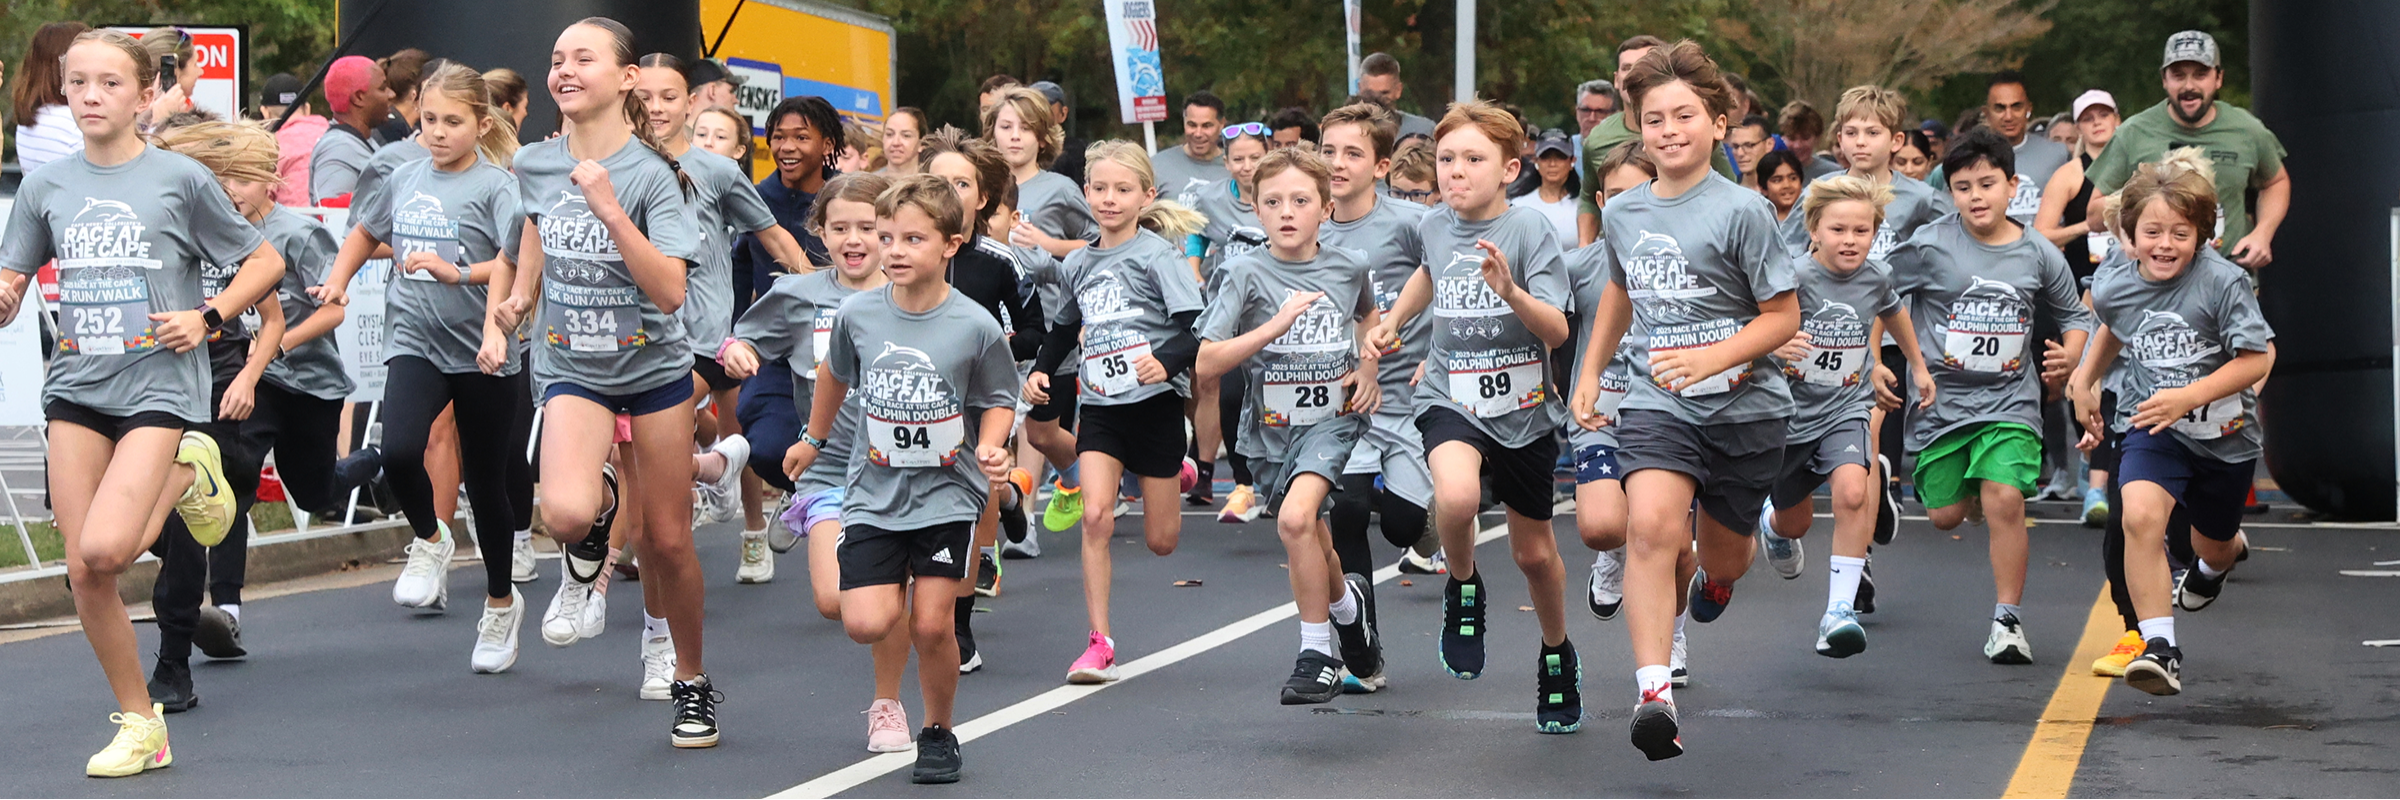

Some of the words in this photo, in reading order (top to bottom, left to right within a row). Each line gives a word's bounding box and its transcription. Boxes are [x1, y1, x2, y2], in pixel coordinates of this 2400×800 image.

[736, 85, 779, 111] ENSKE
[64, 226, 116, 244] RACE
[116, 225, 146, 241] AT
[393, 223, 400, 233] 5K
[402, 225, 454, 238] RUN/WALK
[540, 217, 588, 238] RACE
[588, 223, 609, 240] AT
[61, 241, 96, 258] THE
[98, 241, 151, 258] CAPE
[401, 238, 438, 260] 275
[570, 237, 619, 253] CAPE
[1626, 259, 1665, 276] RACE
[1667, 259, 1689, 275] AT
[74, 281, 88, 289] RACE
[89, 281, 97, 289] AT
[99, 280, 113, 288] THE
[114, 279, 134, 287] CAPE
[566, 284, 583, 294] RACE
[1437, 279, 1478, 296] RACE
[1480, 281, 1495, 295] A
[1626, 275, 1652, 290] THE
[1653, 274, 1699, 289] CAPE
[60, 289, 69, 301] 5K
[72, 286, 142, 302] RUN/WALK
[549, 288, 561, 302] 5K
[563, 292, 634, 306] RUN/WALK
[1107, 286, 1124, 301] AT
[1436, 292, 1463, 309] THE
[1094, 298, 1131, 315] CAPE
[1952, 302, 2001, 316] RACE
[2001, 302, 2025, 316] AT
[73, 307, 124, 335] 252
[564, 309, 618, 333] 334
[1319, 312, 1342, 329] AT
[1656, 327, 1671, 335] 2025
[1672, 326, 1690, 334] RACE
[1692, 324, 1700, 332] AT
[1701, 321, 1716, 330] THE
[1716, 318, 1735, 328] CAPE
[1949, 320, 1989, 332] DOLPHIN
[1990, 322, 2023, 332] DOUBLE
[1274, 329, 1302, 345] HE
[1302, 327, 1344, 345] CAPE
[1650, 333, 1697, 348] DOLPHIN
[1837, 336, 1867, 347] DOUBLE
[2132, 332, 2174, 350] RACE
[2177, 331, 2198, 345] AT
[1084, 343, 1111, 357] DOLPHIN
[1111, 334, 1147, 350] DOUBLE
[1489, 349, 1497, 357] AT
[1971, 336, 2000, 356] 20
[2131, 347, 2162, 360] THE
[2163, 340, 2207, 358] CAPE
[359, 350, 373, 362] EYE
[1449, 359, 1493, 371] DOLPHIN
[1495, 351, 1538, 367] DOUBLE
[1814, 350, 1843, 371] 45
[1102, 354, 1128, 378] 35
[1264, 370, 1312, 382] DOLPHIN
[1315, 361, 1349, 381] DOUBLE
[1289, 363, 1307, 371] RACE
[1318, 362, 1331, 370] THE
[866, 371, 915, 391] RACE
[915, 376, 943, 393] AT
[1603, 371, 1617, 380] 2025
[863, 384, 895, 400] THE
[897, 389, 948, 403] CAPE
[1479, 372, 1511, 399] 89
[886, 400, 904, 409] RACE
[905, 402, 914, 410] AT
[916, 402, 929, 410] THE
[931, 398, 950, 409] CAPE
[1295, 385, 1329, 408] 28
[867, 402, 910, 421] DOLPHIN
[913, 404, 958, 422] DOUBLE
[893, 426, 931, 449] 94
